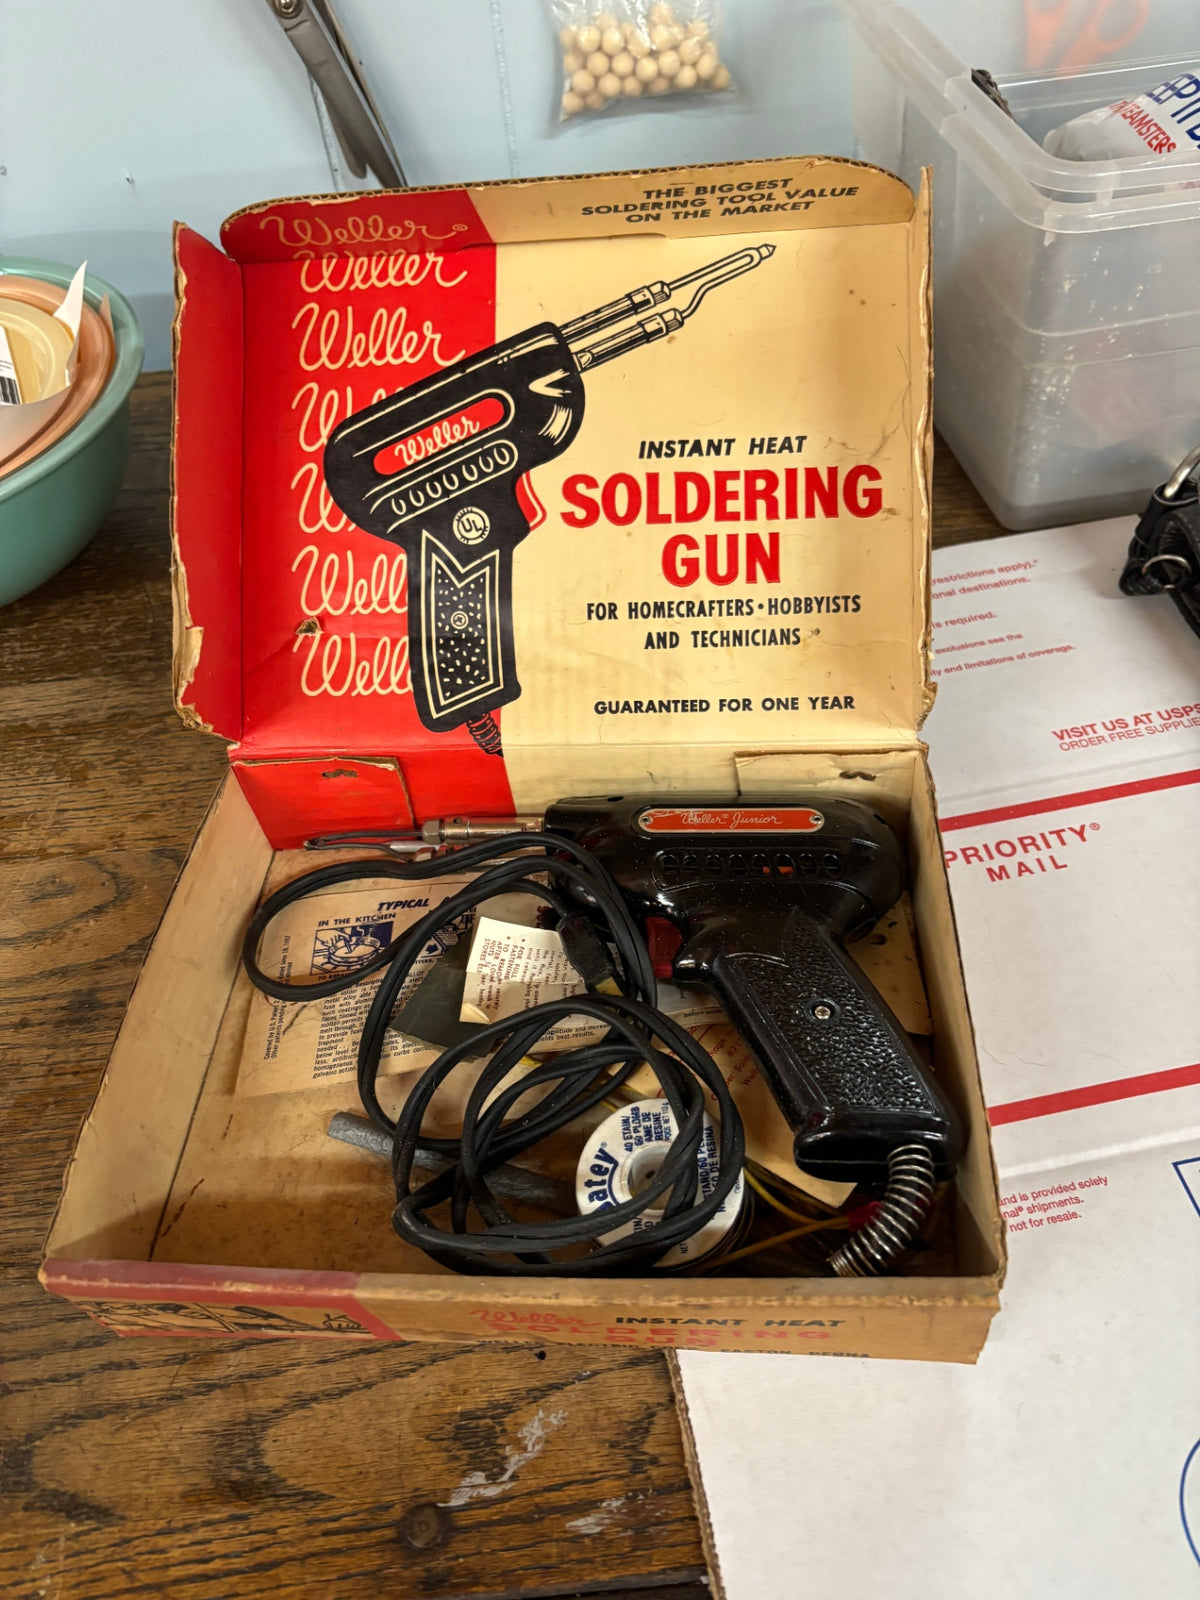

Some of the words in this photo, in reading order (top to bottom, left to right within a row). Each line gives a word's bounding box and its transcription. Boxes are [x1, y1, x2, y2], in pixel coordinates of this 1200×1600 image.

[1121, 103, 1177, 154] TEAMSTERS
[643, 187, 685, 200] THE
[695, 178, 793, 196] BIGGEST
[582, 197, 707, 216] SOLDERING
[717, 192, 776, 206] TOOL
[785, 186, 859, 200] VALUE
[626, 213, 661, 223] ON
[672, 209, 710, 220] THE
[720, 201, 814, 217] MARKET
[293, 249, 467, 293] Weller
[291, 302, 466, 371] Weller
[393, 416, 480, 465] Weller
[638, 437, 736, 459] INSTANT
[748, 435, 808, 455] HEAT
[560, 464, 883, 529] SOLDERING
[661, 532, 781, 588] GUN
[291, 545, 408, 616] Well
[958, 575, 1031, 595] destinations.
[587, 602, 618, 620] FOR
[945, 611, 998, 627] required.
[644, 631, 680, 649] AND
[691, 628, 801, 648] TECHNICIANS
[293, 631, 414, 696] Well
[944, 664, 963, 674] and
[964, 654, 1015, 670] limitations
[594, 700, 710, 715] GUARANTEED
[718, 697, 753, 712] FOR
[761, 696, 799, 711] ONE
[808, 695, 855, 710] YEAR
[1052, 723, 1097, 741] VISIT
[1102, 718, 1130, 732] US
[1132, 712, 1157, 726] AT
[1059, 735, 1108, 751] ORDER
[1111, 728, 1142, 743] FREE
[730, 811, 783, 829] Junior
[985, 855, 1068, 882] MAIL
[377, 898, 429, 912] TYPICAL
[334, 917, 351, 925] THE
[355, 912, 396, 923] KITCHEN
[641, 1111, 651, 1123] DE
[652, 1111, 664, 1141] RESINE
[705, 1125, 718, 1159] RESINA
[1019, 1193, 1029, 1201] is
[1031, 1182, 1077, 1201] provided
[1078, 1175, 1108, 1190] solely
[1026, 1195, 1084, 1214] shipments.
[1009, 1221, 1028, 1232] not
[1029, 1218, 1044, 1229] for
[1046, 1210, 1082, 1225] resale.
[469, 1308, 604, 1327] Weller
[616, 1316, 748, 1326] INSTANT
[764, 1319, 848, 1327] HEAT
[488, 1323, 831, 1340] SOLDERING
